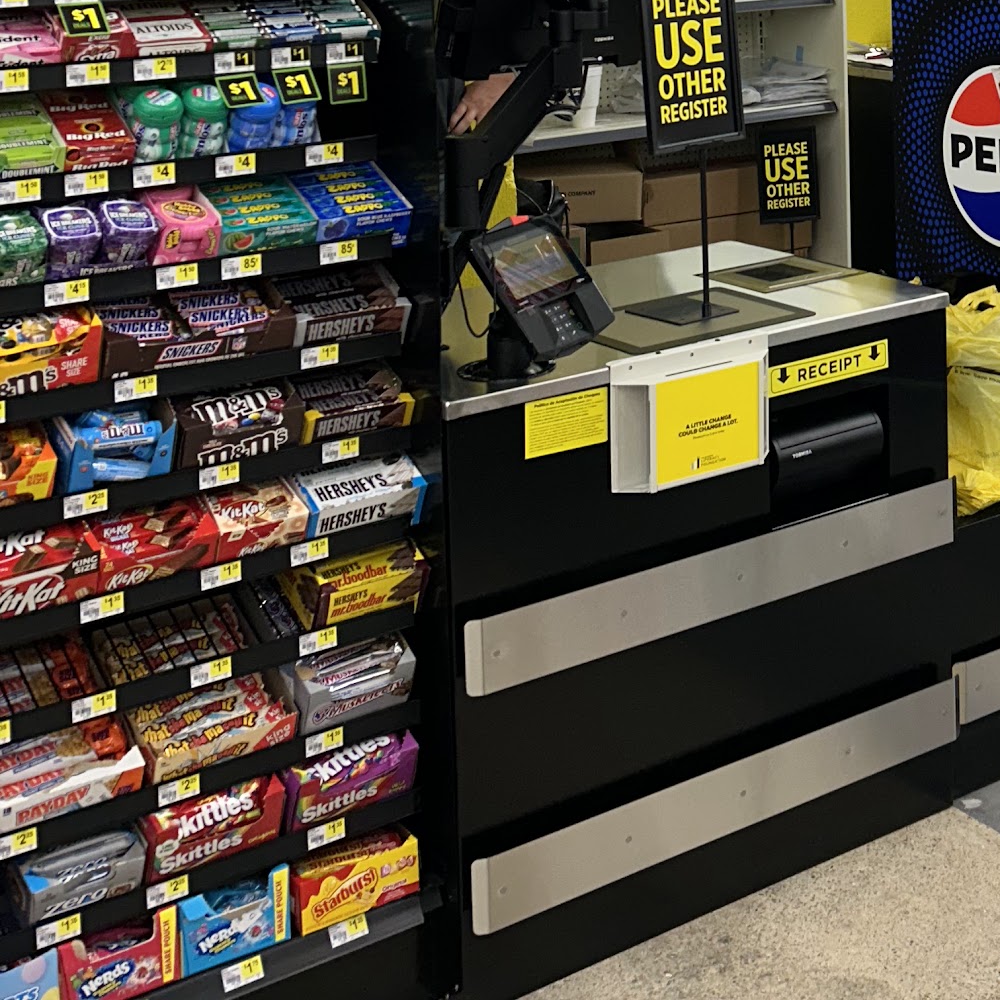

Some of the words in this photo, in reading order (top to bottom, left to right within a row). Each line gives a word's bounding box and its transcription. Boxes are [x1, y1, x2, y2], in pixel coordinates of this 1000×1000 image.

[71, 7, 101, 30] $1
[135, 22, 194, 34] ALTOIDS
[347, 43, 358, 56] $1
[654, 17, 724, 70] USE
[237, 53, 249, 65] $1
[293, 48, 305, 61] $1
[228, 80, 257, 101] $1
[285, 73, 312, 96] $1
[338, 70, 360, 96] $1
[658, 67, 727, 100] OTHER
[660, 96, 728, 125] REGISTER
[66, 132, 92, 142] Big
[93, 129, 126, 140] Red
[327, 145, 339, 156] $4
[763, 141, 808, 158] PLEASE
[238, 155, 250, 168] $4
[765, 156, 810, 183] USE
[2, 165, 56, 180] DOUBLEMINT
[157, 165, 169, 178] $4
[568, 190, 596, 198] COMPANY
[766, 182, 811, 198] OTHER
[767, 196, 811, 210] REGISTER
[179, 294, 238, 310] SNICKERS
[100, 308, 159, 320] SNICKERS
[191, 308, 250, 322] SNICKERS
[108, 321, 170, 333] SNICKERS
[308, 314, 376, 341] HERSHEY'S
[162, 341, 219, 359] SNICKERS
[61, 357, 88, 370] SHARE
[798, 354, 861, 382] RECEIPT
[66, 368, 81, 378] SIZE
[317, 410, 381, 438] HERSHEY'S
[678, 428, 697, 438] COULD
[699, 422, 721, 433] CHANGE
[727, 418, 739, 426] LOT.
[691, 419, 708, 429] LITTLE
[709, 413, 732, 425] CHANGE
[27, 478, 48, 487] SIZE
[28, 471, 49, 481] KING
[314, 473, 388, 502] HERSHEY'S
[320, 503, 387, 534] HERSHEY'S
[72, 554, 98, 569] KING
[74, 562, 98, 574] SIZE
[334, 589, 368, 606] HERSHEY'S
[265, 723, 291, 743] king
[17, 785, 91, 826] PAYDAY
[301, 783, 379, 824] Skittles
[159, 834, 243, 876] Skittles
[313, 868, 378, 920] Starburst
[41, 886, 108, 921] zero
[162, 920, 171, 949] POUCH
[163, 949, 172, 974] SHARE
